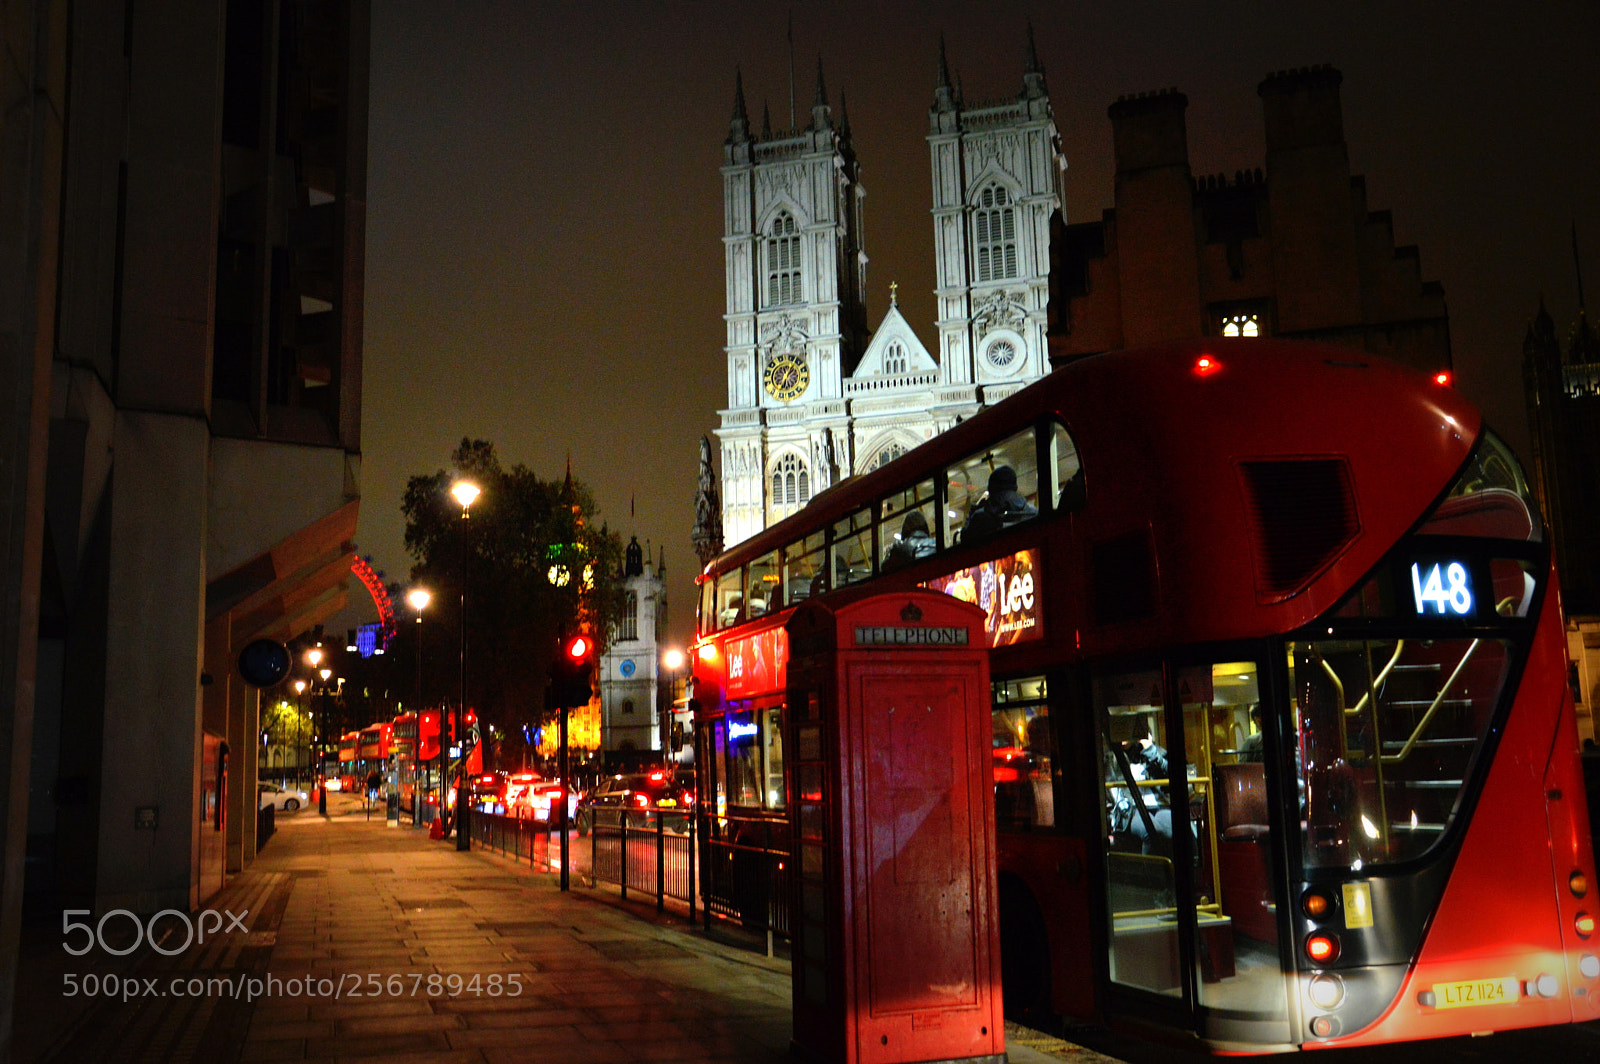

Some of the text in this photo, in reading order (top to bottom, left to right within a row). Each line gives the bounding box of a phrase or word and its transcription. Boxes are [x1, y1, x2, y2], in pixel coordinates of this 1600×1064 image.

[999, 572, 1034, 616] Lee
[1411, 562, 1472, 614] 148
[858, 627, 965, 644] TELEPHONE
[729, 652, 743, 679] Lee
[1445, 981, 1503, 1004] LTZ 1124
